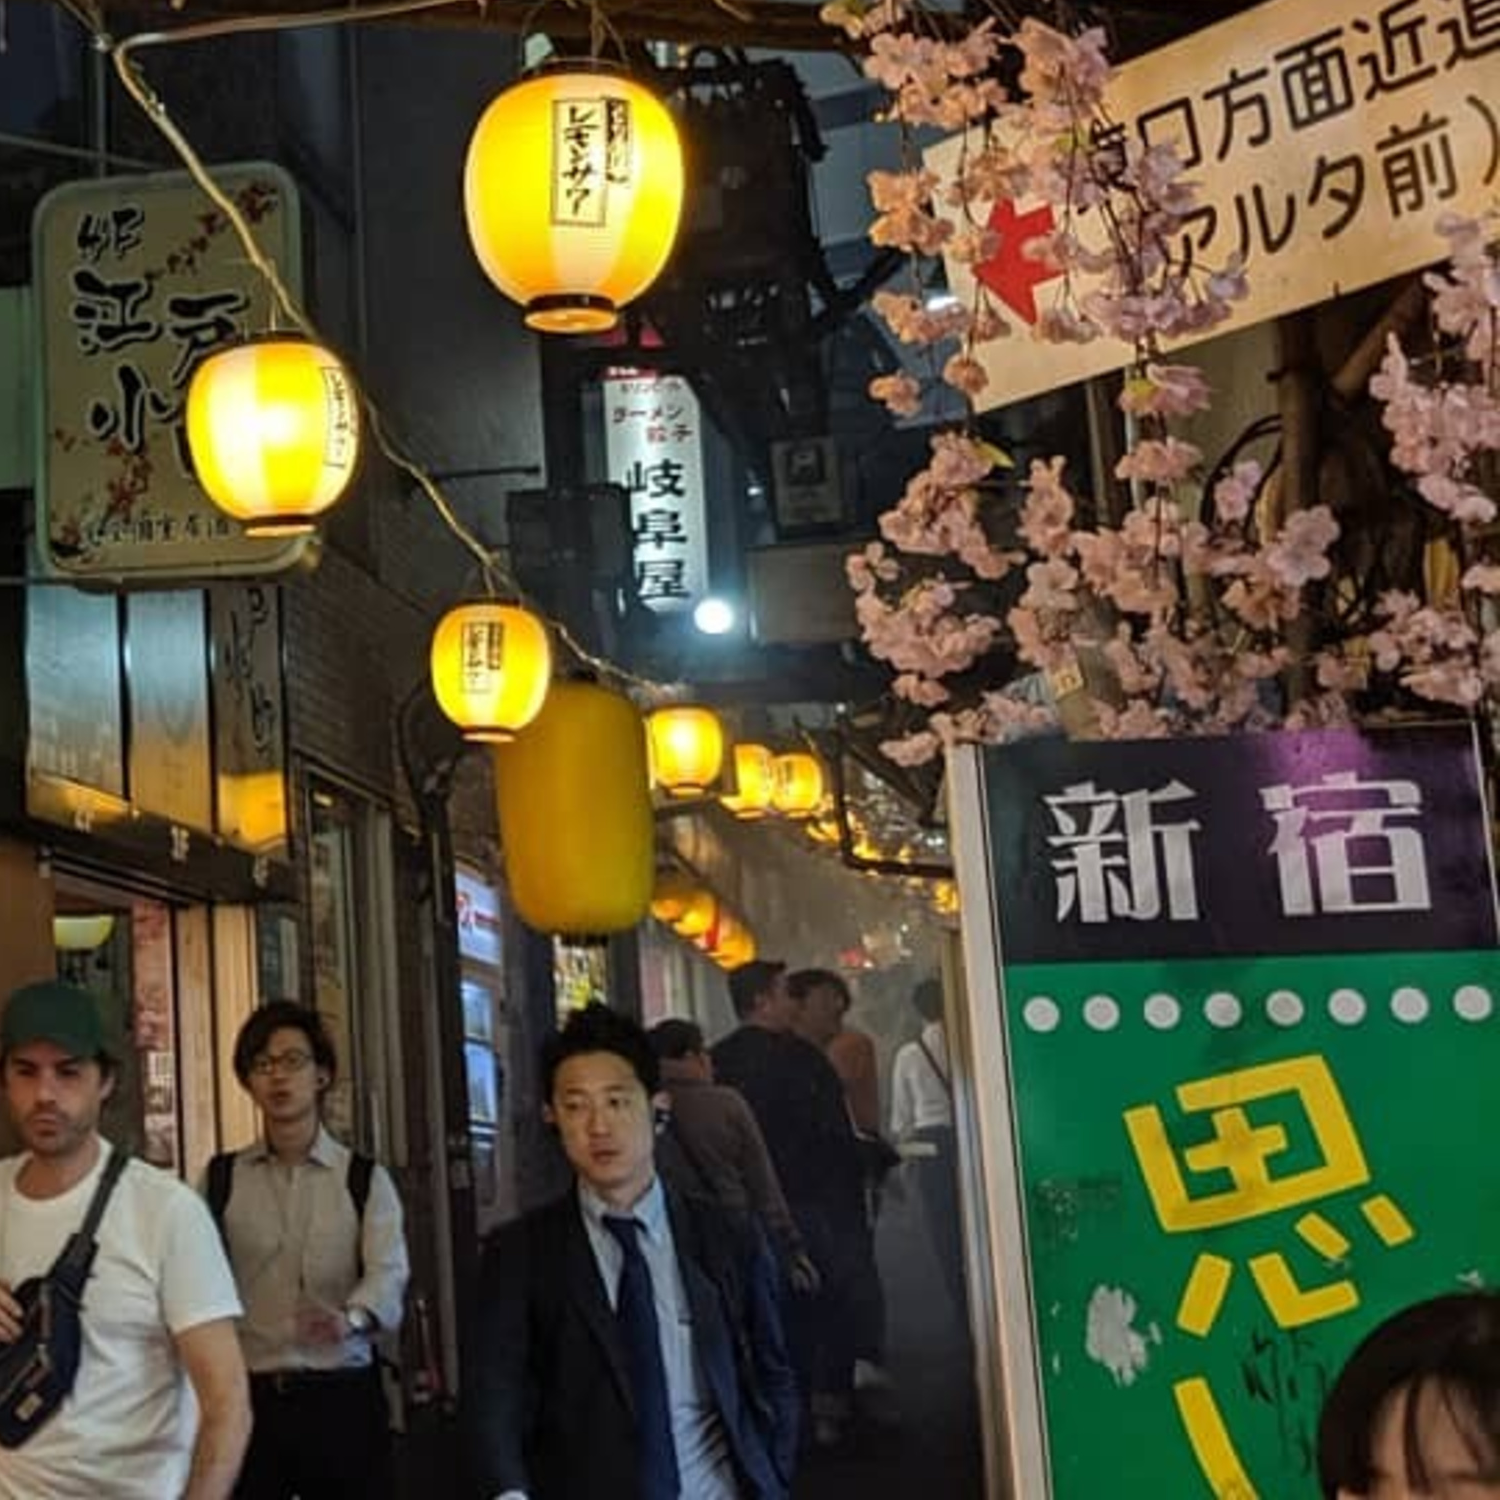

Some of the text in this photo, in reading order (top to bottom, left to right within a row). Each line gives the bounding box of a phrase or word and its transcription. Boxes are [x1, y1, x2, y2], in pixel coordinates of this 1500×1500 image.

[626, 458, 690, 601] 岐阜屋
[1043, 772, 1432, 923] 新宿
